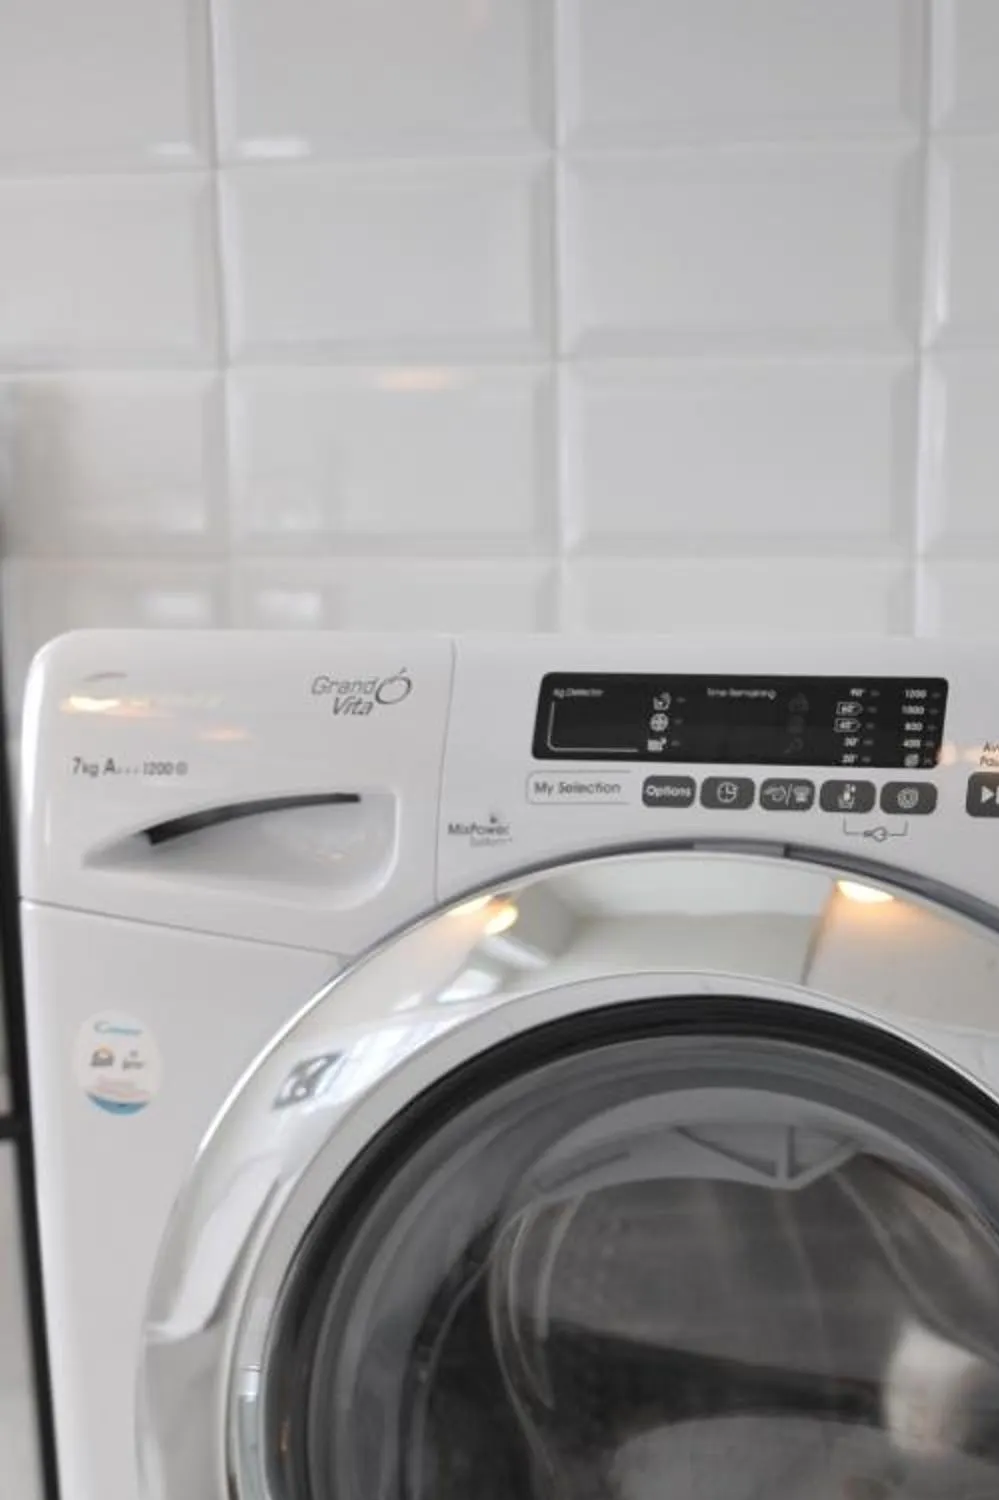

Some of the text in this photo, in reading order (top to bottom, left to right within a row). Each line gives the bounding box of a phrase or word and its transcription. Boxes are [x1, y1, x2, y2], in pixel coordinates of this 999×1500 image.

[312, 674, 380, 695] Grand
[333, 697, 373, 716] Vita
[533, 782, 622, 798] My Selection
[646, 784, 692, 798] Options
